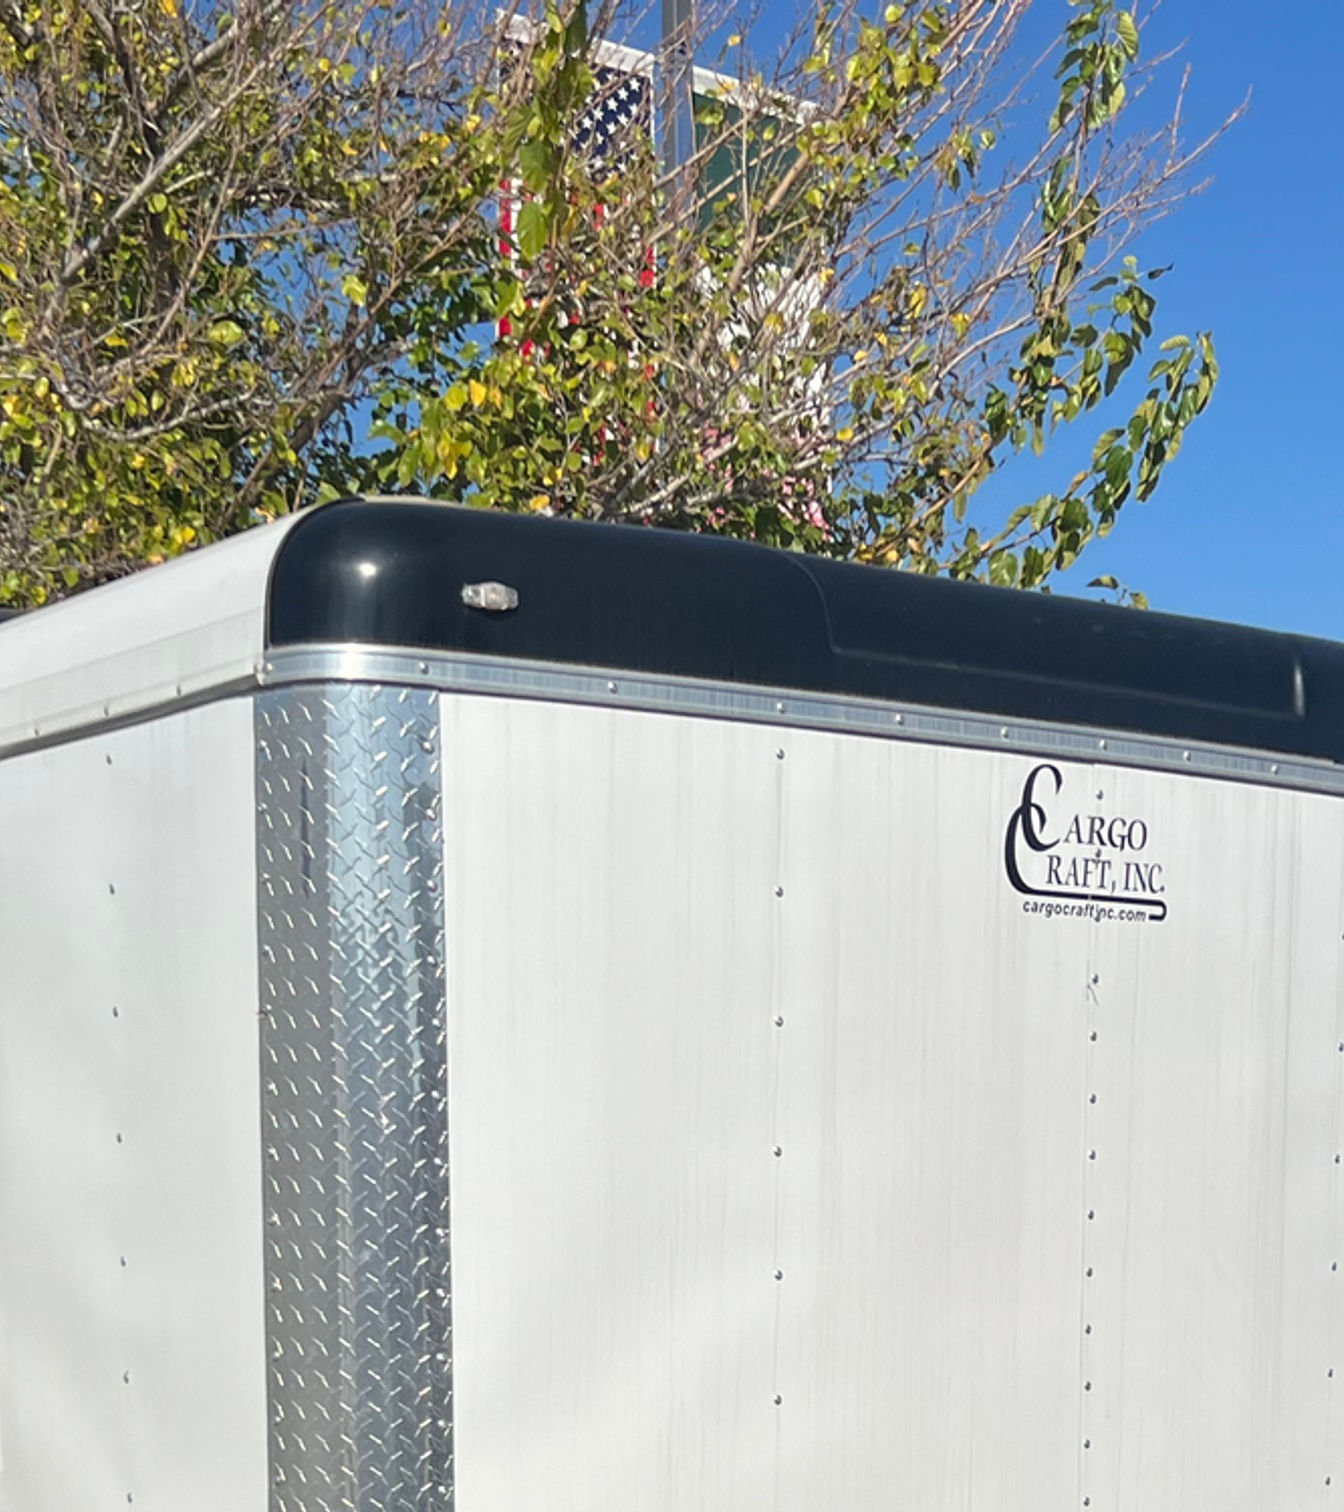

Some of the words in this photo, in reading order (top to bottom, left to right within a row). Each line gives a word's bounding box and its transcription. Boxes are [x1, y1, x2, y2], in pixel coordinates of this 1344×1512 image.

[1021, 763, 1148, 852] CARGO
[1123, 861, 1166, 894] INC.
[1022, 900, 1147, 922] cargocraftinc.com
